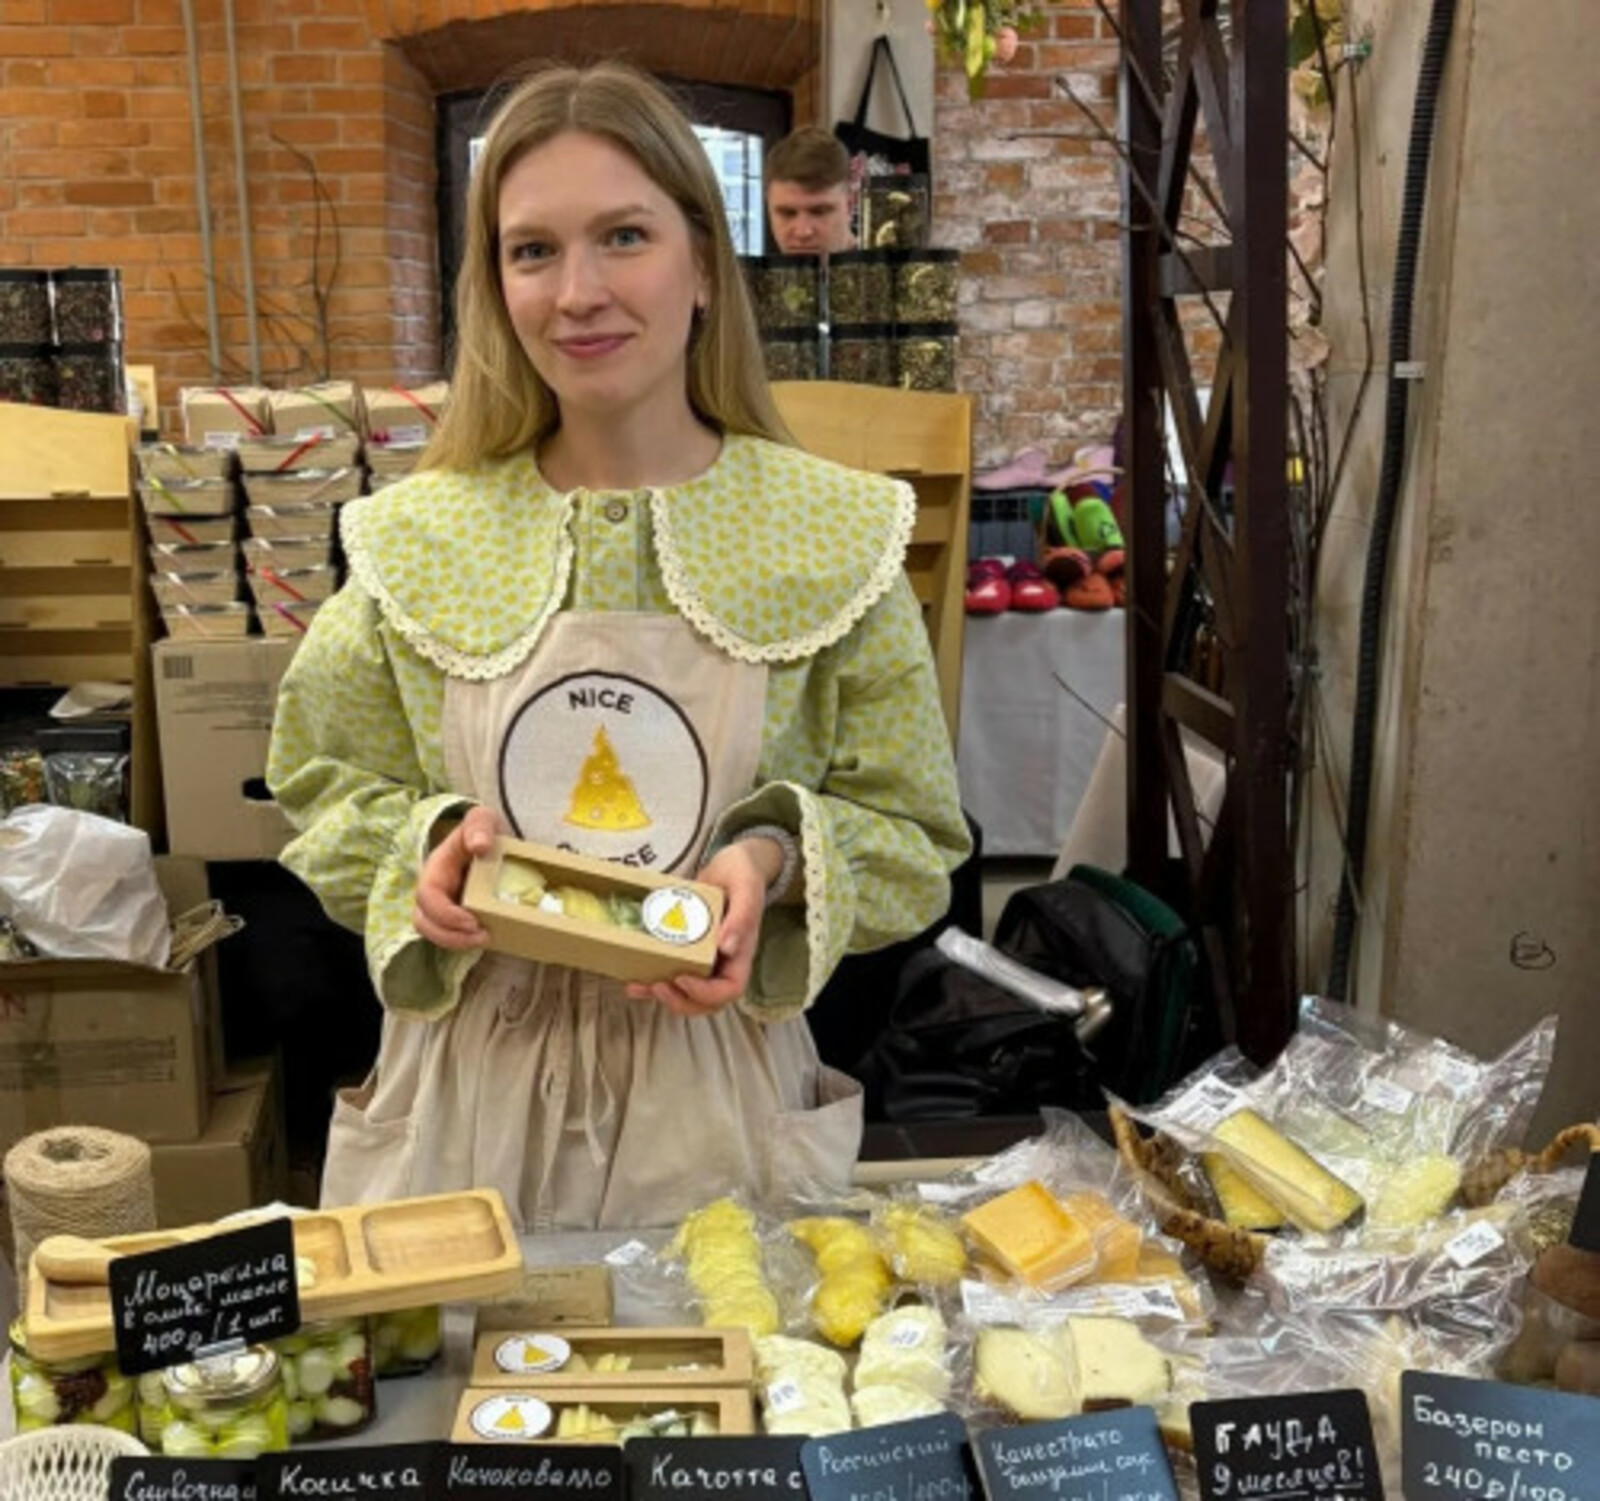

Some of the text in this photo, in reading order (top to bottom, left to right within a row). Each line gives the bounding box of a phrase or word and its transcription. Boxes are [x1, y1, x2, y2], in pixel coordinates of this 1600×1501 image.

[568, 687, 635, 715] NICE
[1473, 1440, 1574, 1473] песто
[278, 1463, 420, 1495] Косичка
